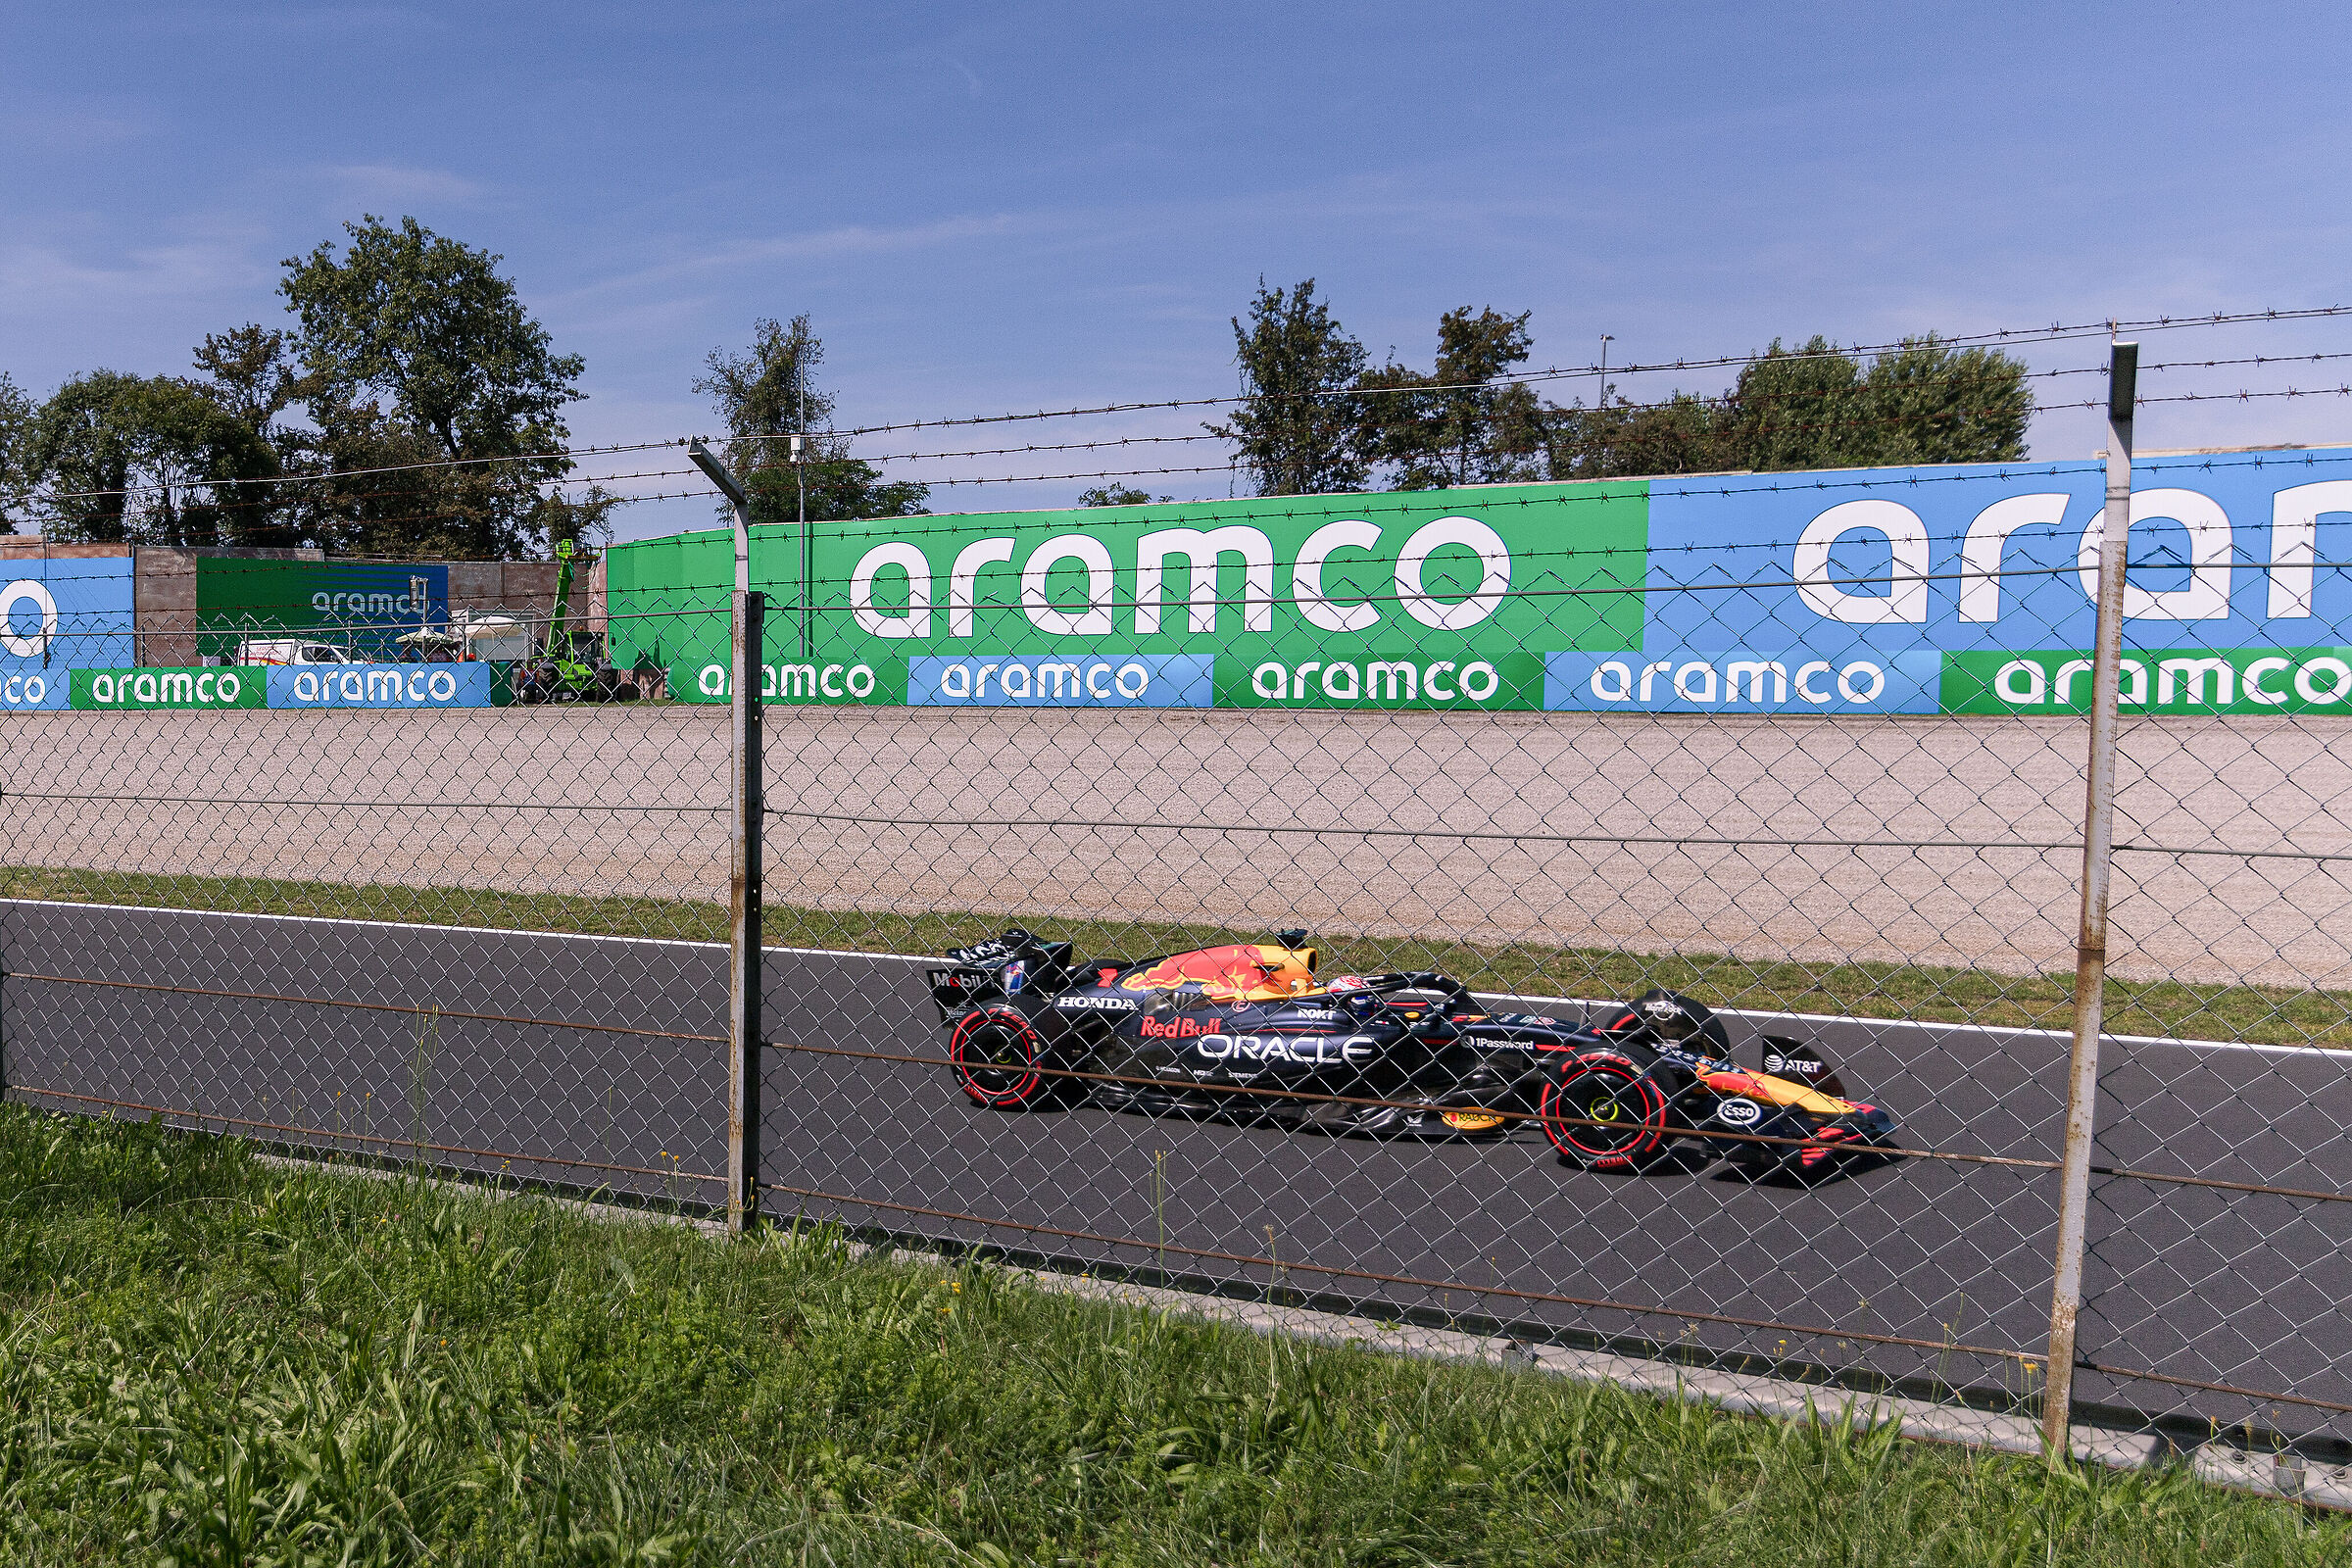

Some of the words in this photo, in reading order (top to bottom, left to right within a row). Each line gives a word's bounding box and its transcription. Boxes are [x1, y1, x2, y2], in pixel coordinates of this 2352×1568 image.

[850, 514, 1512, 638] aramco
[92, 673, 242, 704] aramco
[294, 669, 457, 703] aramco
[698, 663, 876, 698] aamco
[940, 662, 1151, 699] aramco
[1250, 661, 1499, 701] aramco
[1590, 660, 1886, 704] aramco
[1993, 657, 2352, 706] aramco
[932, 972, 981, 988] Mobil
[1057, 996, 1138, 1010] HONDA
[1140, 1015, 1181, 1039] Red
[1179, 1017, 1222, 1038] Bull
[1197, 1034, 1376, 1064] ORACLE
[1475, 1037, 1535, 1051] 1Password
[1785, 1059, 1823, 1073] AT&T
